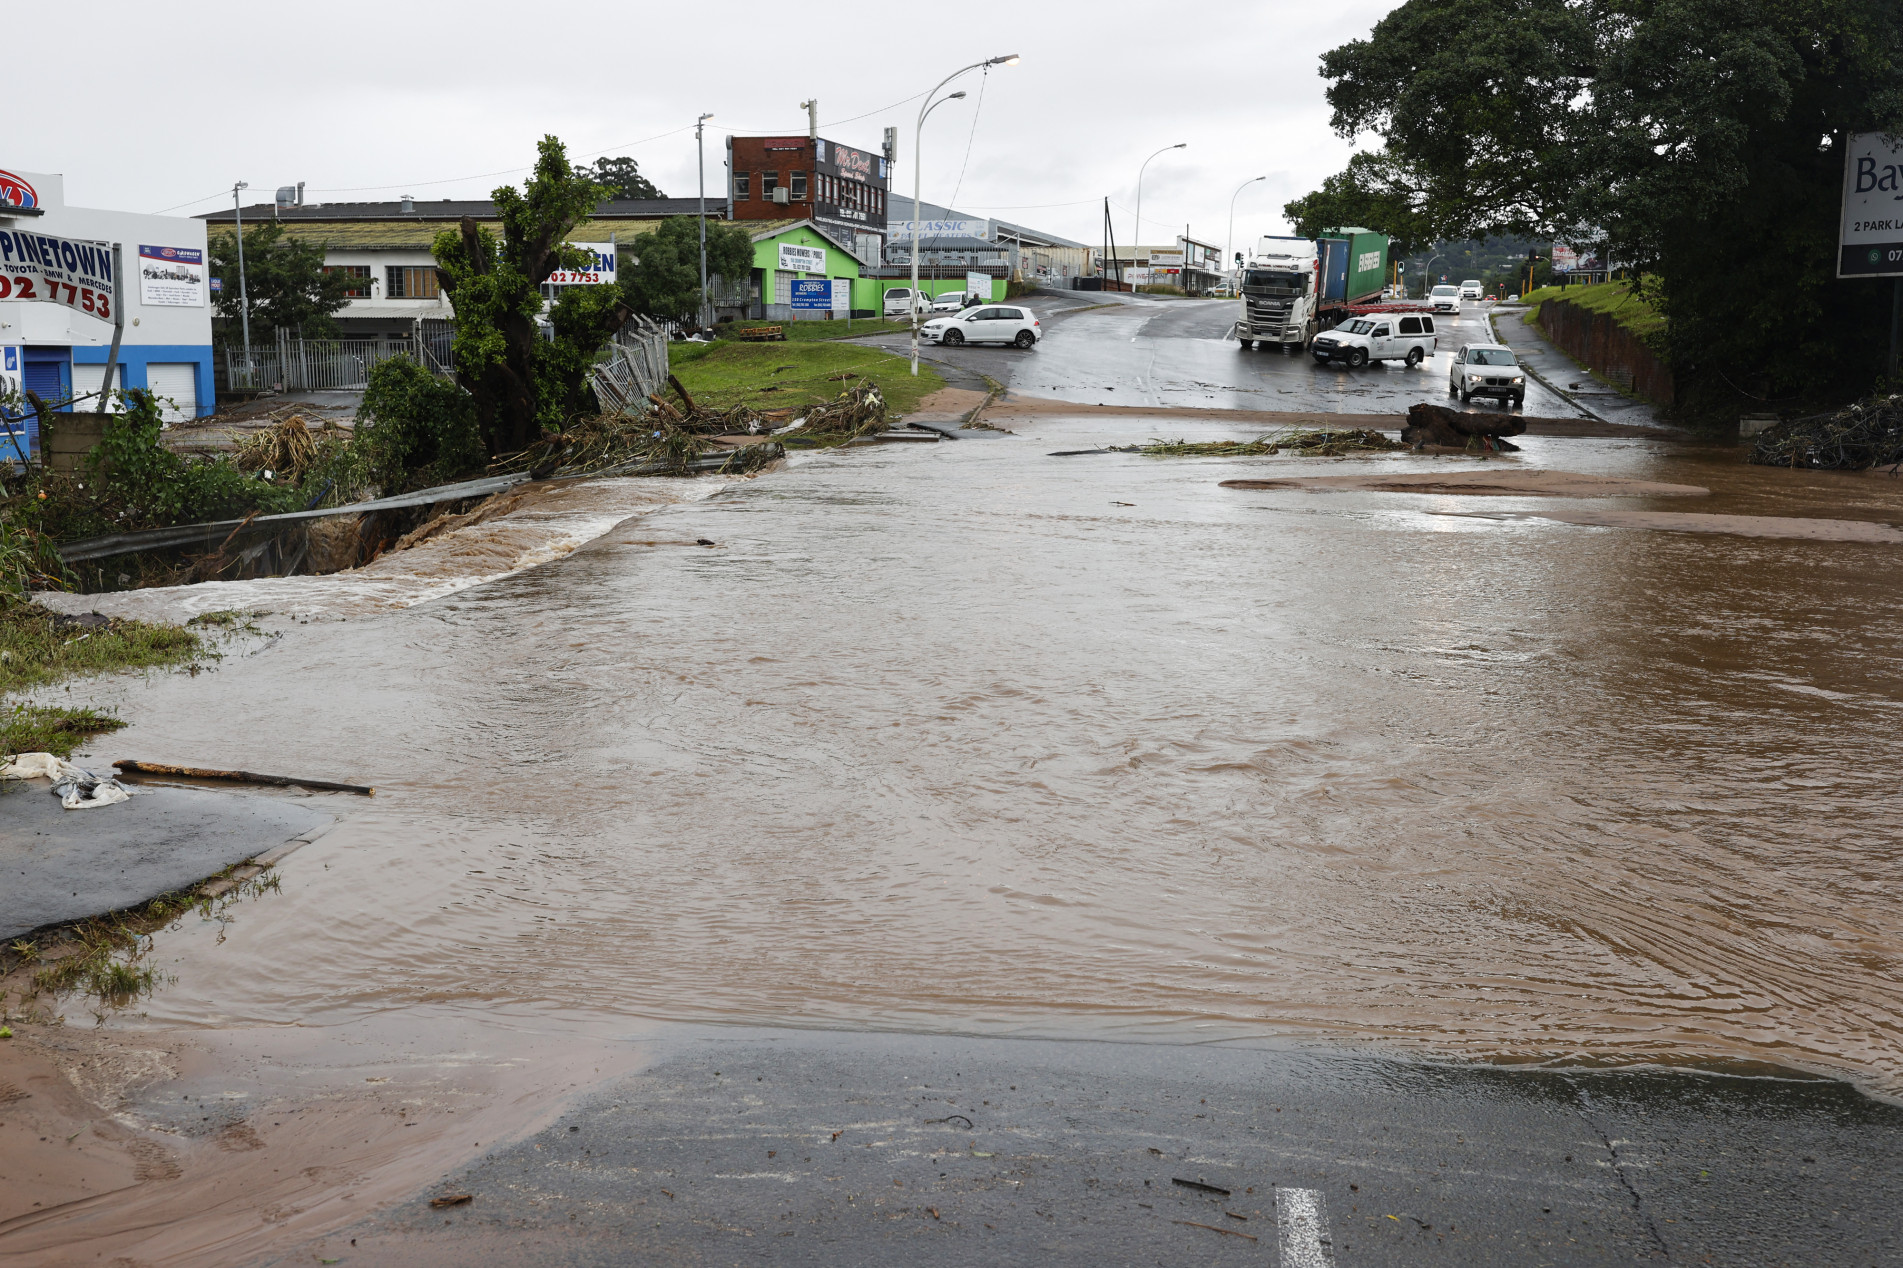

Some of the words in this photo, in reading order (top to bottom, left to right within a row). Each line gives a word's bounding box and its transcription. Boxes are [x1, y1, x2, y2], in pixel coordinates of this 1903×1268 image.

[1854, 222, 1861, 231] 2
[1863, 220, 1893, 231] PARK
[0, 231, 112, 283] PINETOWN
[4, 264, 39, 274] TOYOTA
[44, 269, 63, 279] BMW
[67, 274, 73, 282] &
[79, 276, 112, 294] MERCEDES
[571, 272, 599, 282] 7753
[43, 277, 110, 319] 7753
[799, 284, 824, 292] ROBBIES
